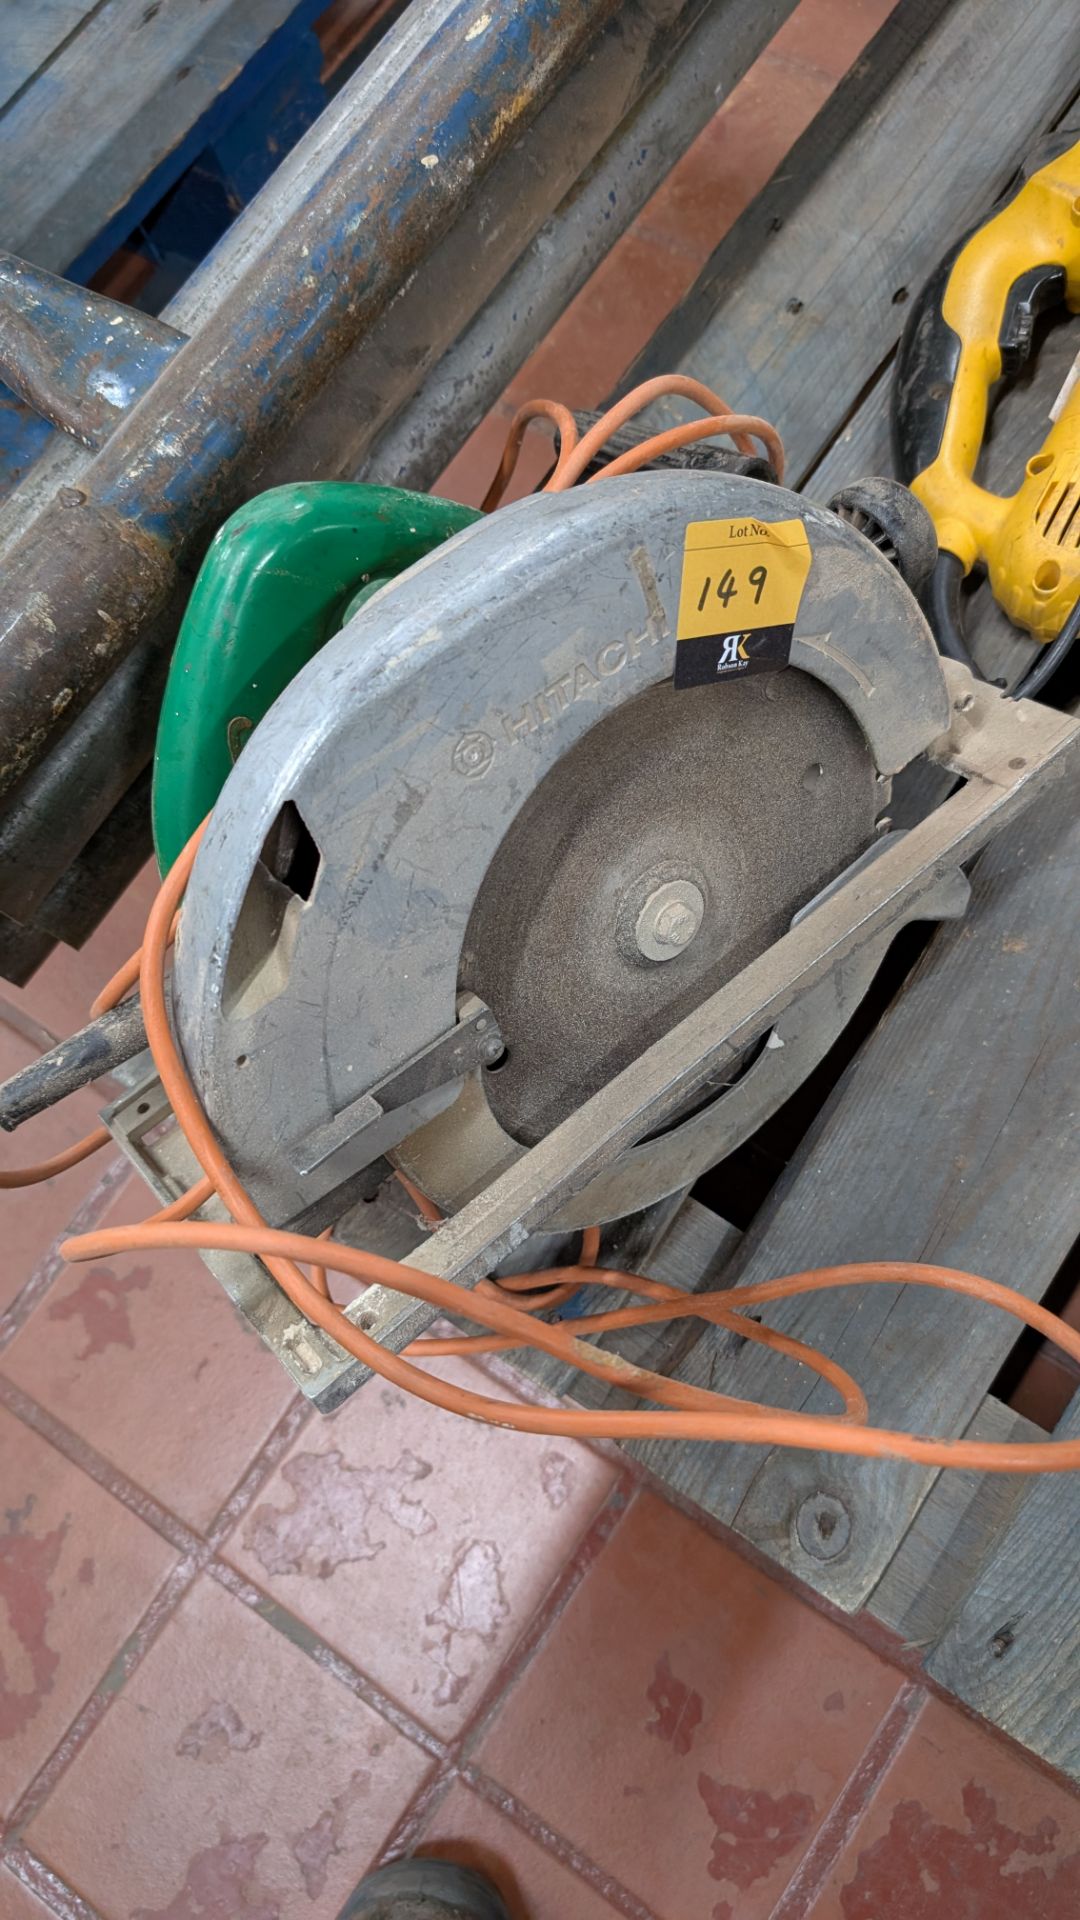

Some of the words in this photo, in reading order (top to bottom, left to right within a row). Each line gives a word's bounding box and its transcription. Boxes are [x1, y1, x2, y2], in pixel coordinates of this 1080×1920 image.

[729, 525, 748, 539] Lot
[697, 566, 768, 612] 149
[501, 607, 671, 746] HITACHI
